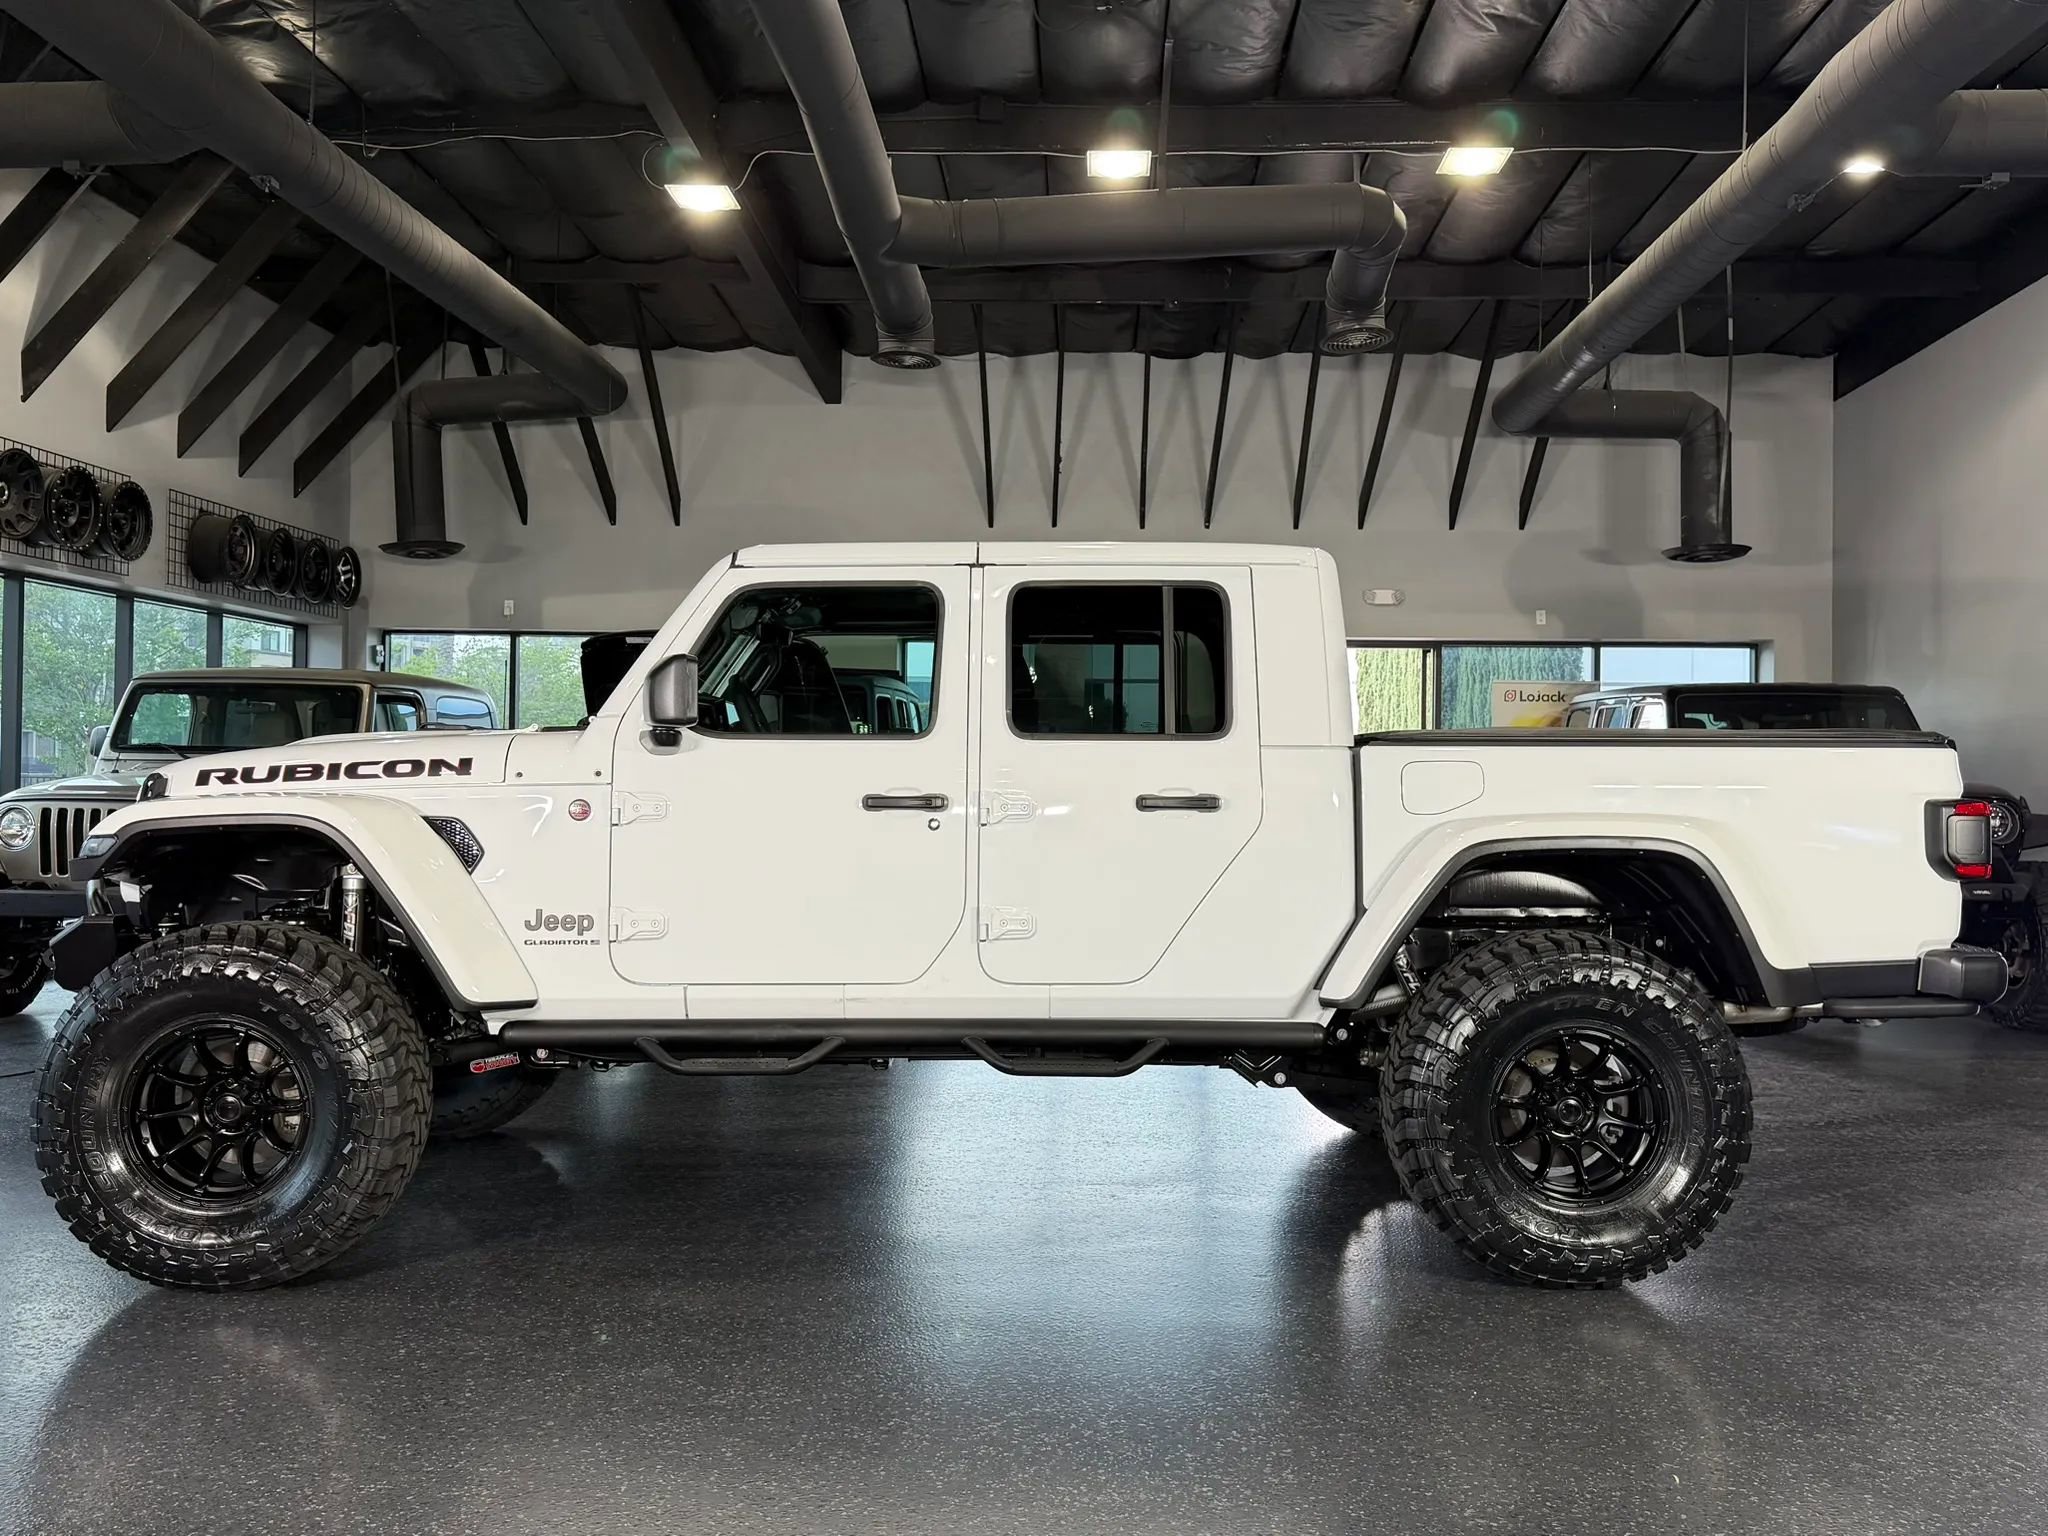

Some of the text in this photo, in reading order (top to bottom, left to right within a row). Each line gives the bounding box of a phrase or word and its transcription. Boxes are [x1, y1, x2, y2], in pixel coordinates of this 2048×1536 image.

[195, 757, 473, 786] RUBICON
[524, 909, 594, 936] Jeep
[1553, 997, 1636, 1018] OPEN
[258, 998, 329, 1070] TOYO
[115, 1198, 196, 1242] OPEN
